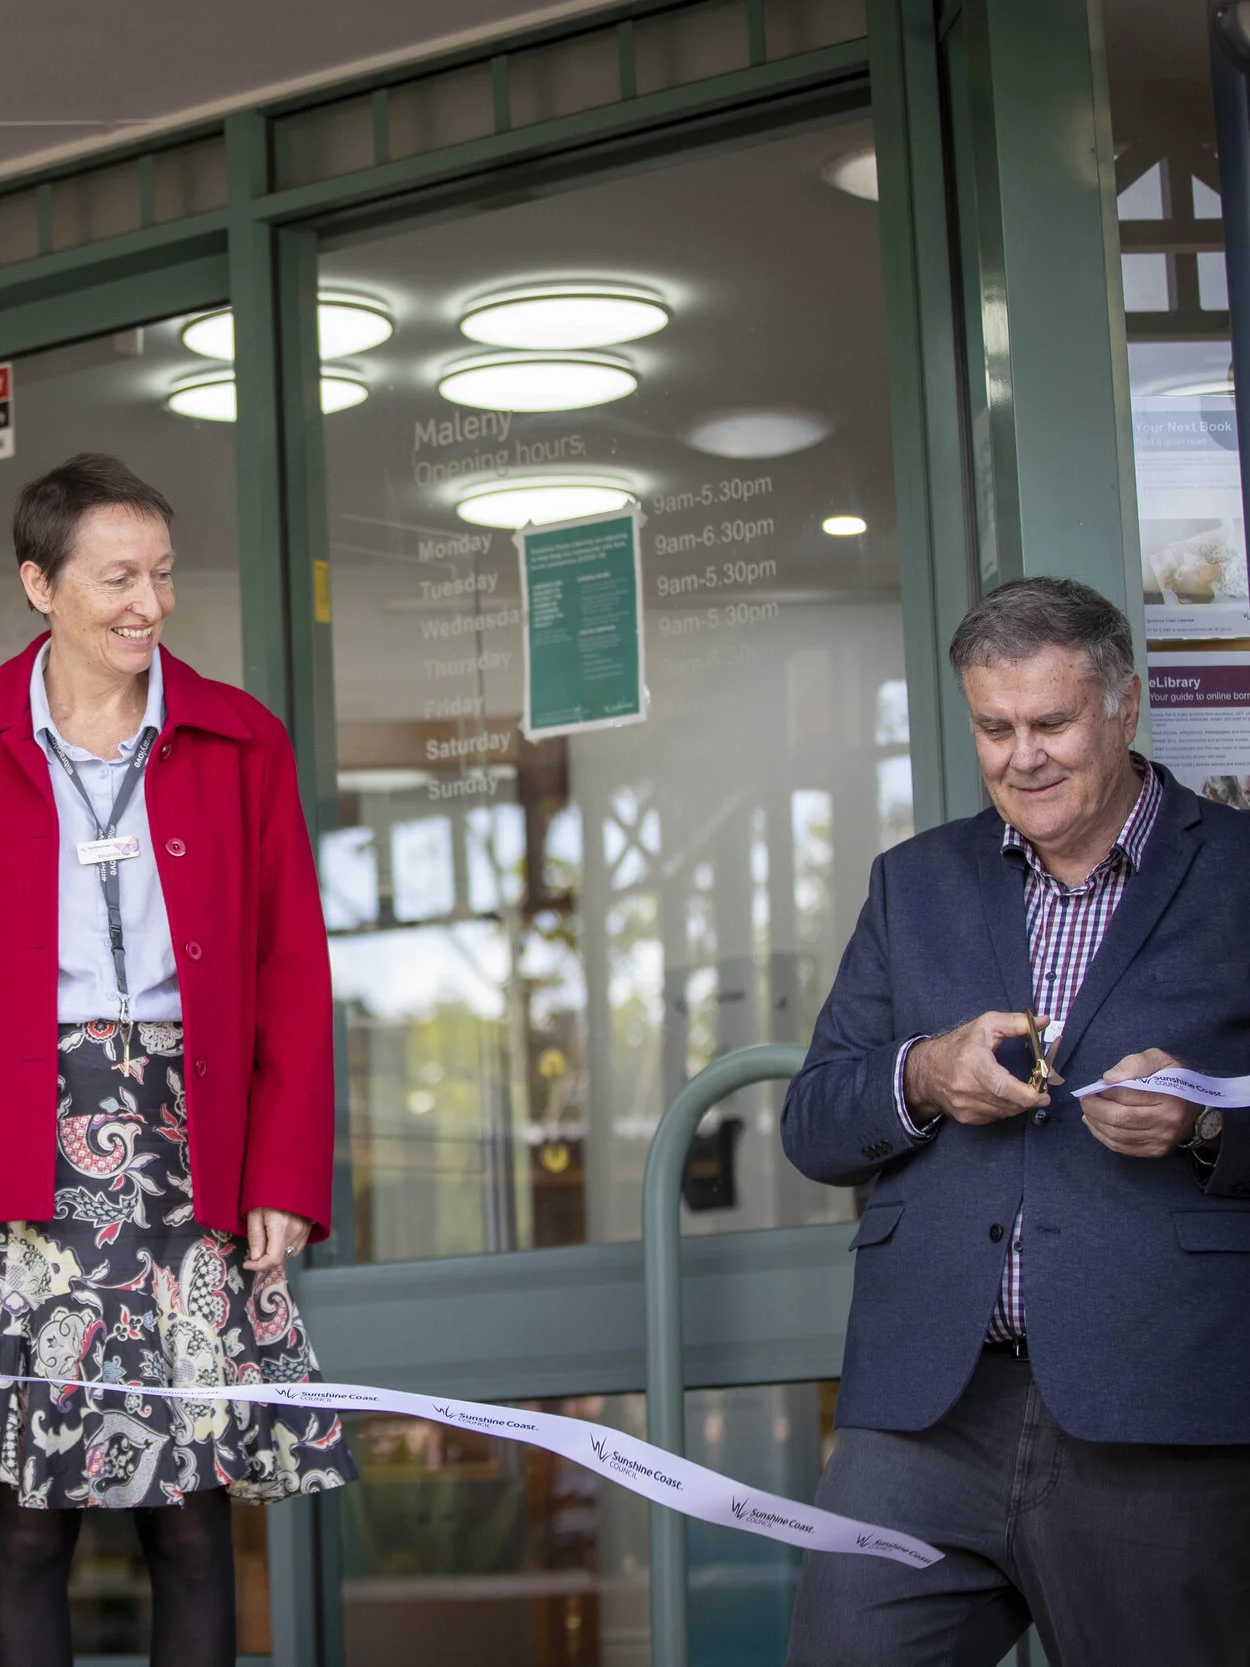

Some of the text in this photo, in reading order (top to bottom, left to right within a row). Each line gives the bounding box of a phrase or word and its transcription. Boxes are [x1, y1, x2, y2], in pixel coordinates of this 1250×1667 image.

[414, 411, 513, 451] Maleny
[1134, 421, 1233, 433] Your Next Book
[415, 434, 582, 488] Opening hours
[653, 476, 773, 515] 9am-5.30pm
[418, 533, 492, 562] Monday
[655, 517, 775, 555] 9am-6.30pm
[419, 571, 498, 601] Tuesday
[657, 559, 777, 597] 9am-5.30pm
[659, 601, 779, 638] 9am-5.30pm
[423, 651, 512, 682] Thursday
[1149, 676, 1201, 690] eLibrary
[424, 695, 483, 719] Friday
[1150, 693, 1169, 701] Your
[1170, 692, 1194, 703] guide
[1196, 692, 1204, 700] to
[1206, 692, 1231, 700] online
[426, 732, 511, 761] Saturday
[428, 775, 499, 801] Sunday
[1152, 1076, 1223, 1097] Sunshine Coast
[1154, 1080, 1186, 1092] COUNCIL
[301, 1391, 379, 1402] Sunshine Coast
[457, 1417, 491, 1429] COUNCIL
[459, 1412, 537, 1431] Sunshine Coast
[609, 1460, 638, 1481] COUNCIL
[611, 1450, 682, 1491] Sunshine Coast
[750, 1508, 814, 1534] Sunshine Coast
